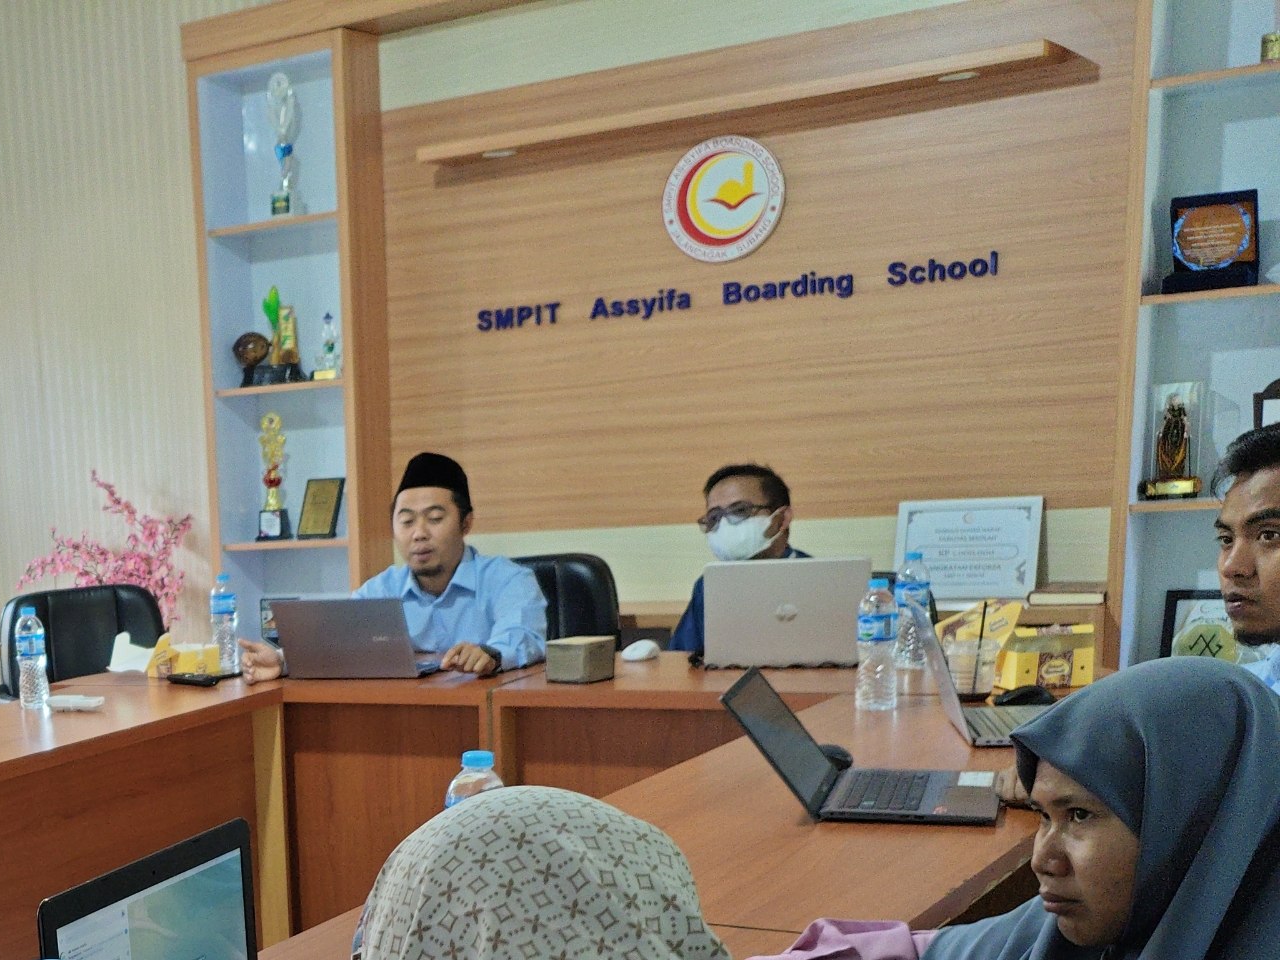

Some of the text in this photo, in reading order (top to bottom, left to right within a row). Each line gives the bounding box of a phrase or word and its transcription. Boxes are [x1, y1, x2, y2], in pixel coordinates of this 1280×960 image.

[477, 251, 999, 331] SMPIT Assyifa Boarding School
